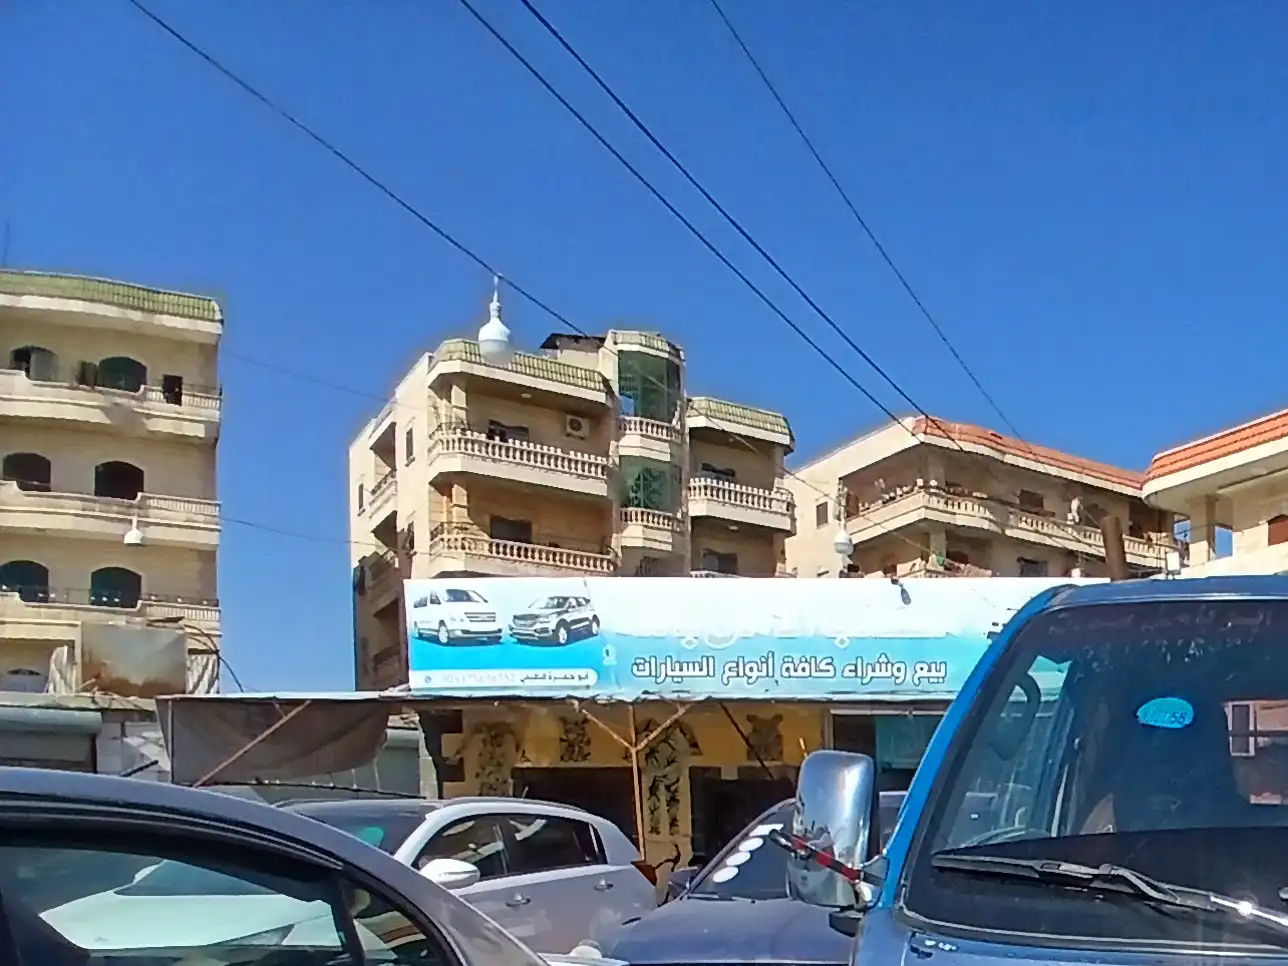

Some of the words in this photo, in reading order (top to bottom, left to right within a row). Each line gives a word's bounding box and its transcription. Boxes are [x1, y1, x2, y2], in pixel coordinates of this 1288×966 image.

[632, 654, 715, 684] السيارات
[721, 652, 775, 684] أنواع
[780, 655, 836, 678] كافة
[841, 653, 910, 684] وشراء
[912, 659, 948, 684] بيع
